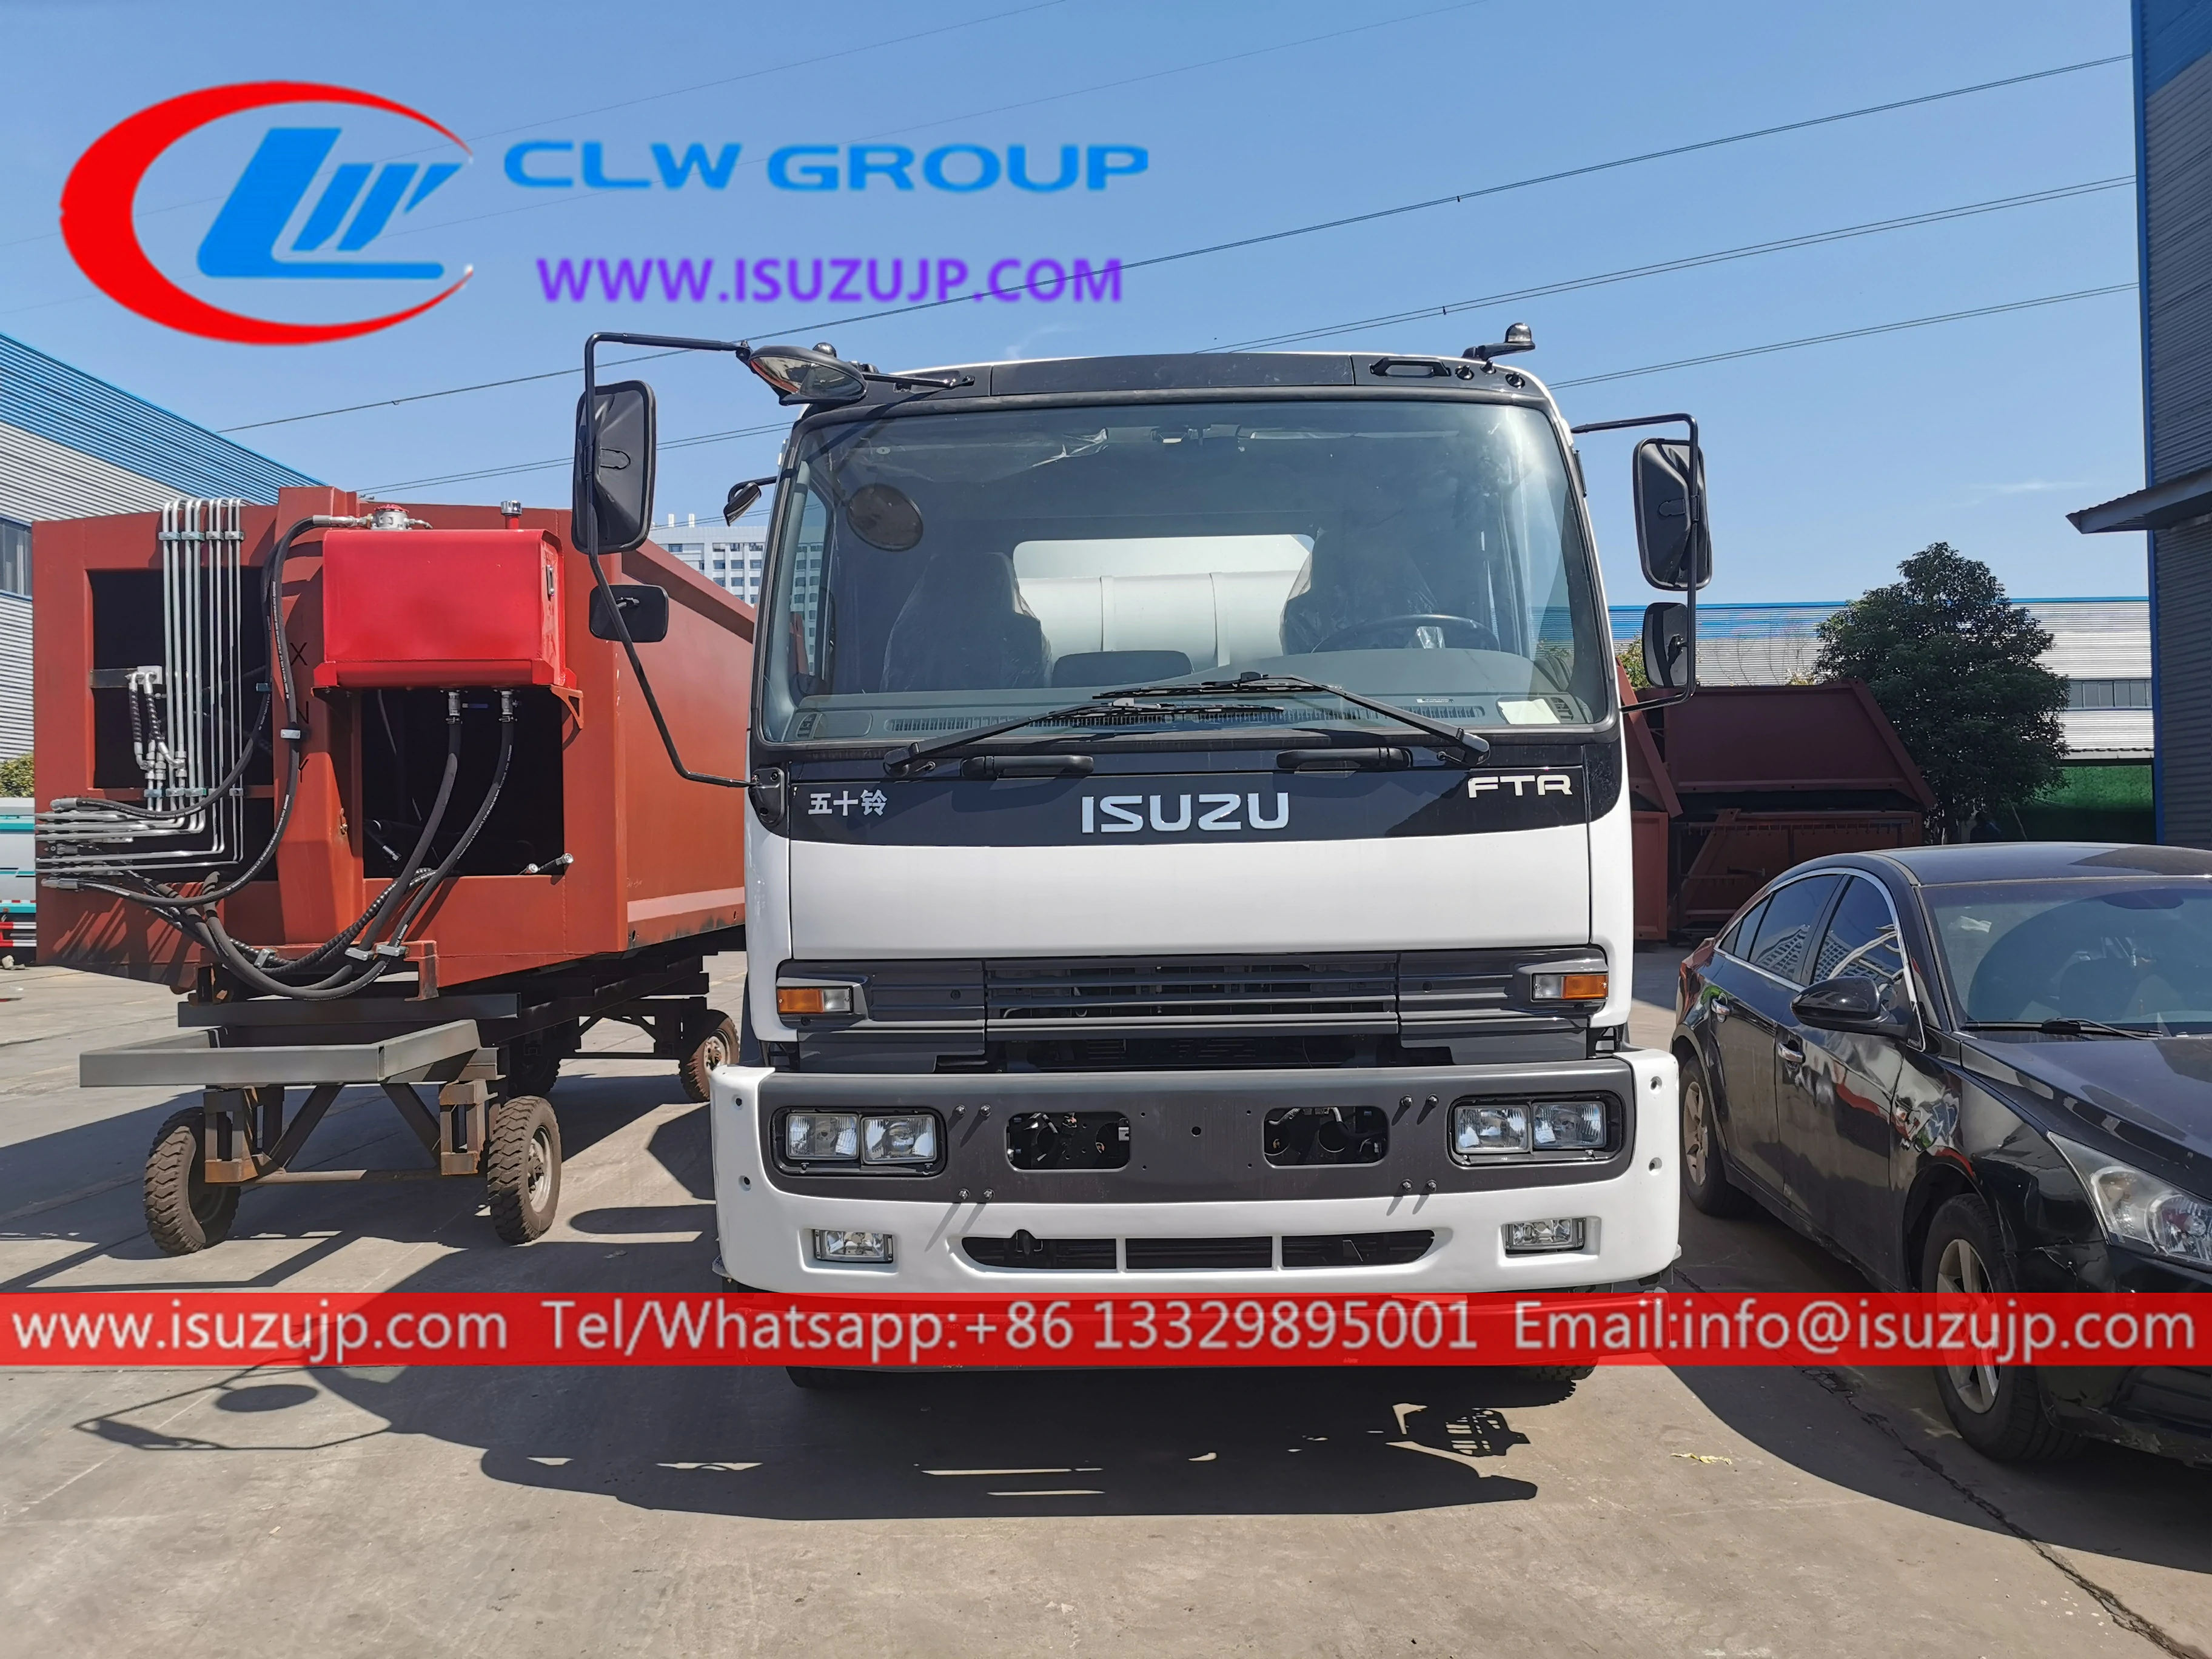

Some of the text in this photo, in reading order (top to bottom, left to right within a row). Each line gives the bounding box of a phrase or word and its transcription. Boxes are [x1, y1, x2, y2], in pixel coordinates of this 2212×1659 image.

[1467, 774, 1574, 799] FTR
[808, 789, 887, 817] 五十铃
[1081, 793, 1290, 834] ISUZU
